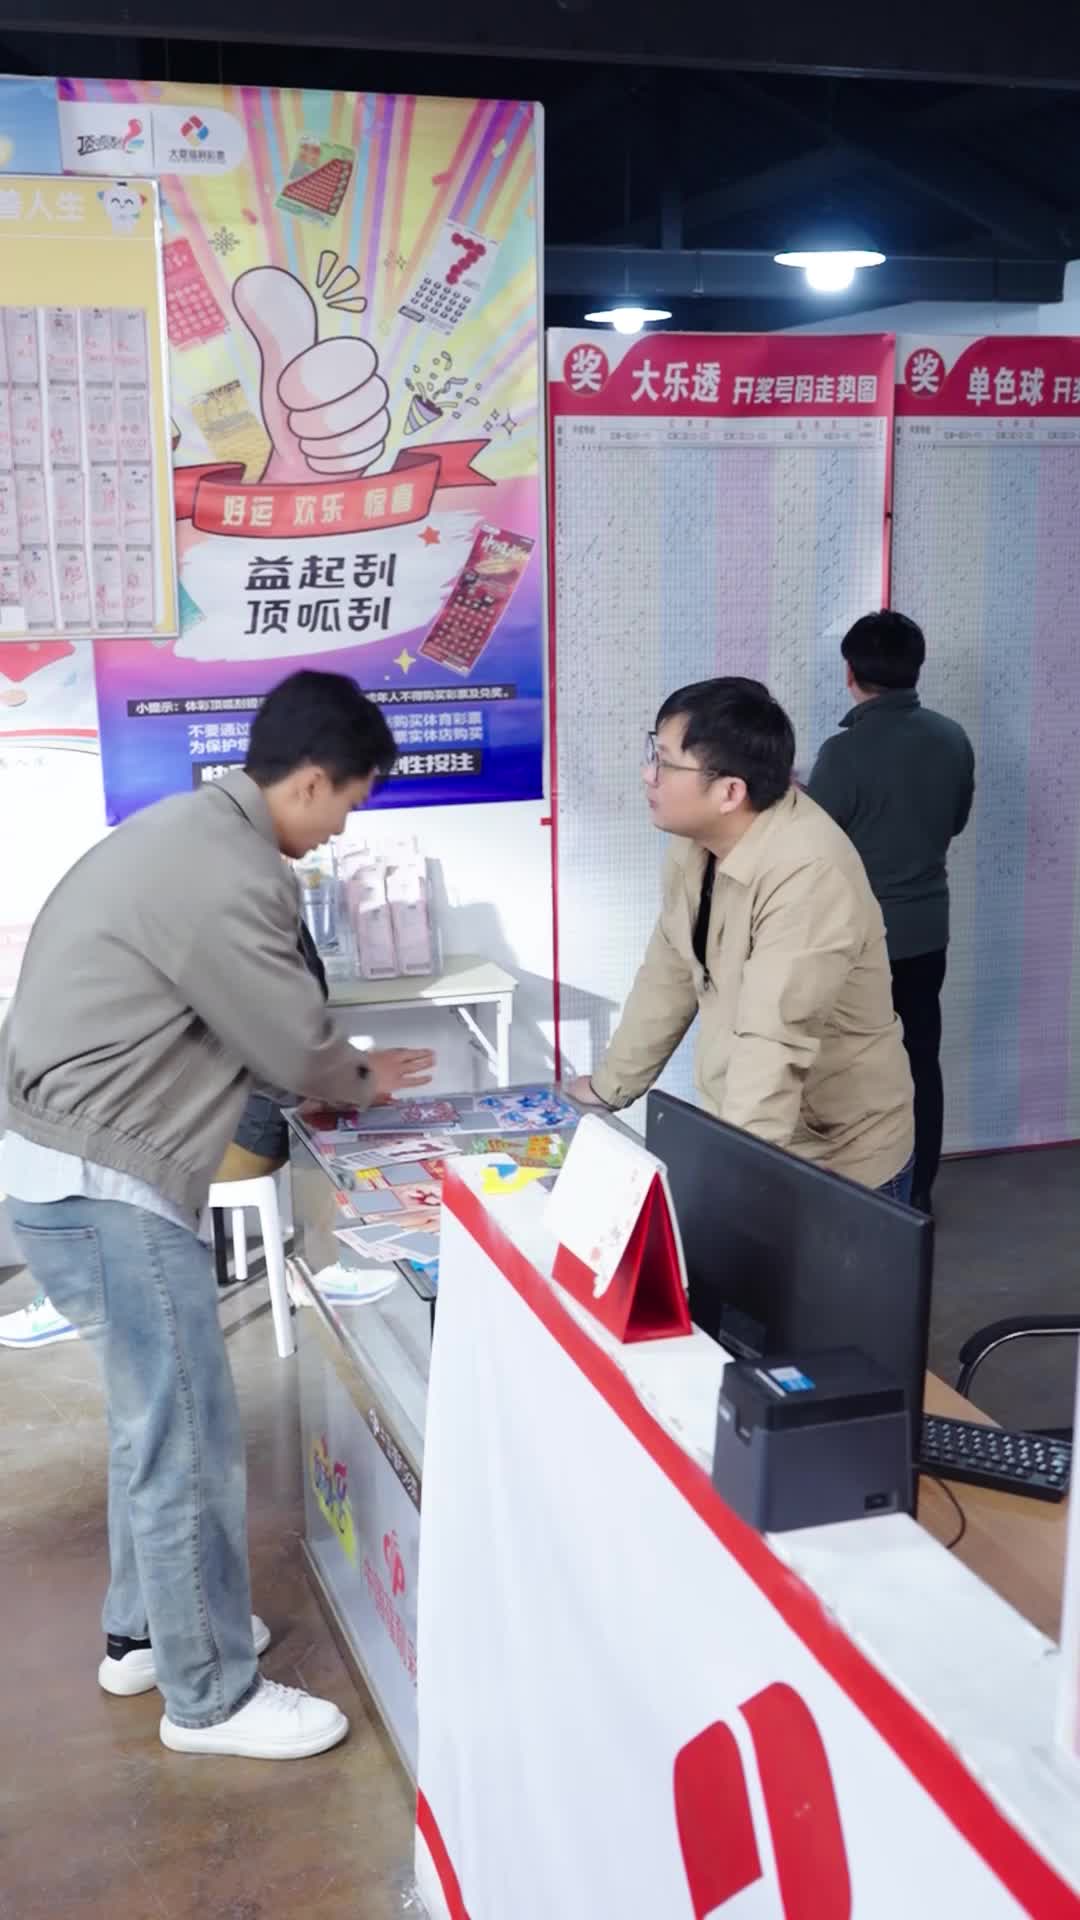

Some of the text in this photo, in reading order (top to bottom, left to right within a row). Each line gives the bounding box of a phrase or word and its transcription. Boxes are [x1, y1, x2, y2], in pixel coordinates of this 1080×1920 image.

[571, 349, 602, 392] 奖
[631, 359, 878, 405] 大乐透 开奖号码走势图
[911, 353, 940, 393] 奖
[966, 366, 1045, 407] 单色球
[221, 495, 275, 527] 好运
[293, 492, 345, 527] 欢乐
[244, 552, 397, 591] 益起刮
[243, 596, 392, 635] 顶呱刮
[187, 722, 250, 739] 不要通过
[389, 752, 475, 775] 性投注
